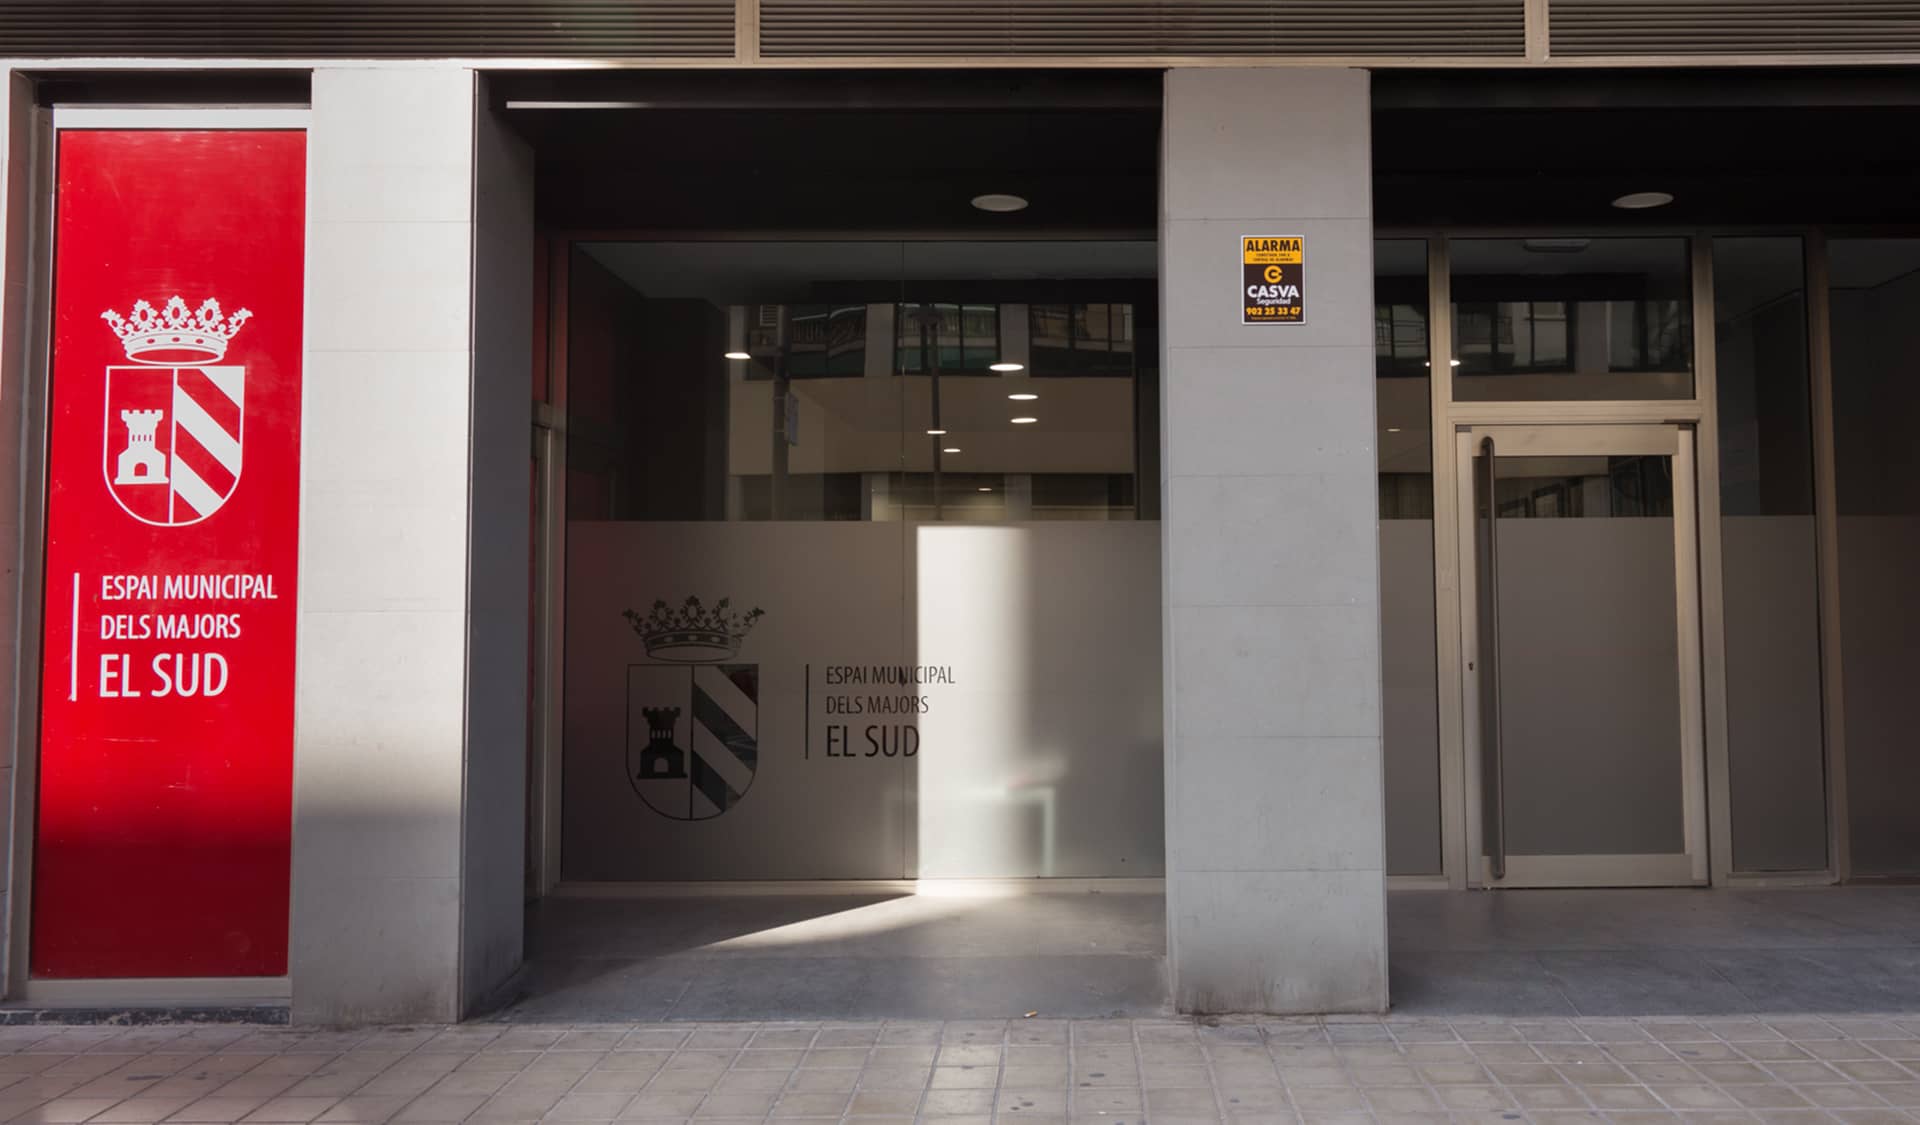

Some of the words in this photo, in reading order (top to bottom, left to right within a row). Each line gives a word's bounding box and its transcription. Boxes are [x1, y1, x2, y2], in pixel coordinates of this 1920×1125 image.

[1246, 240, 1300, 252] ALARMA
[1247, 285, 1300, 298] CASVA
[1246, 307, 1262, 316] 902
[1265, 307, 1275, 316] 25
[1277, 307, 1288, 316] 33
[1290, 307, 1301, 316] 47
[1256, 298, 1291, 306] Seguridad
[101, 575, 158, 600] ESPAI
[163, 574, 278, 599] MUNICIPAL
[100, 614, 151, 640] DELS
[156, 613, 241, 639] MAJORS
[99, 653, 141, 698] EL
[151, 652, 229, 697] SUD
[826, 666, 867, 685] ESPAI
[872, 665, 956, 685] MUNICIPAL
[826, 696, 863, 714] DELS
[867, 695, 929, 714] MAJORS
[826, 725, 857, 757] EL
[864, 725, 920, 758] SUD
